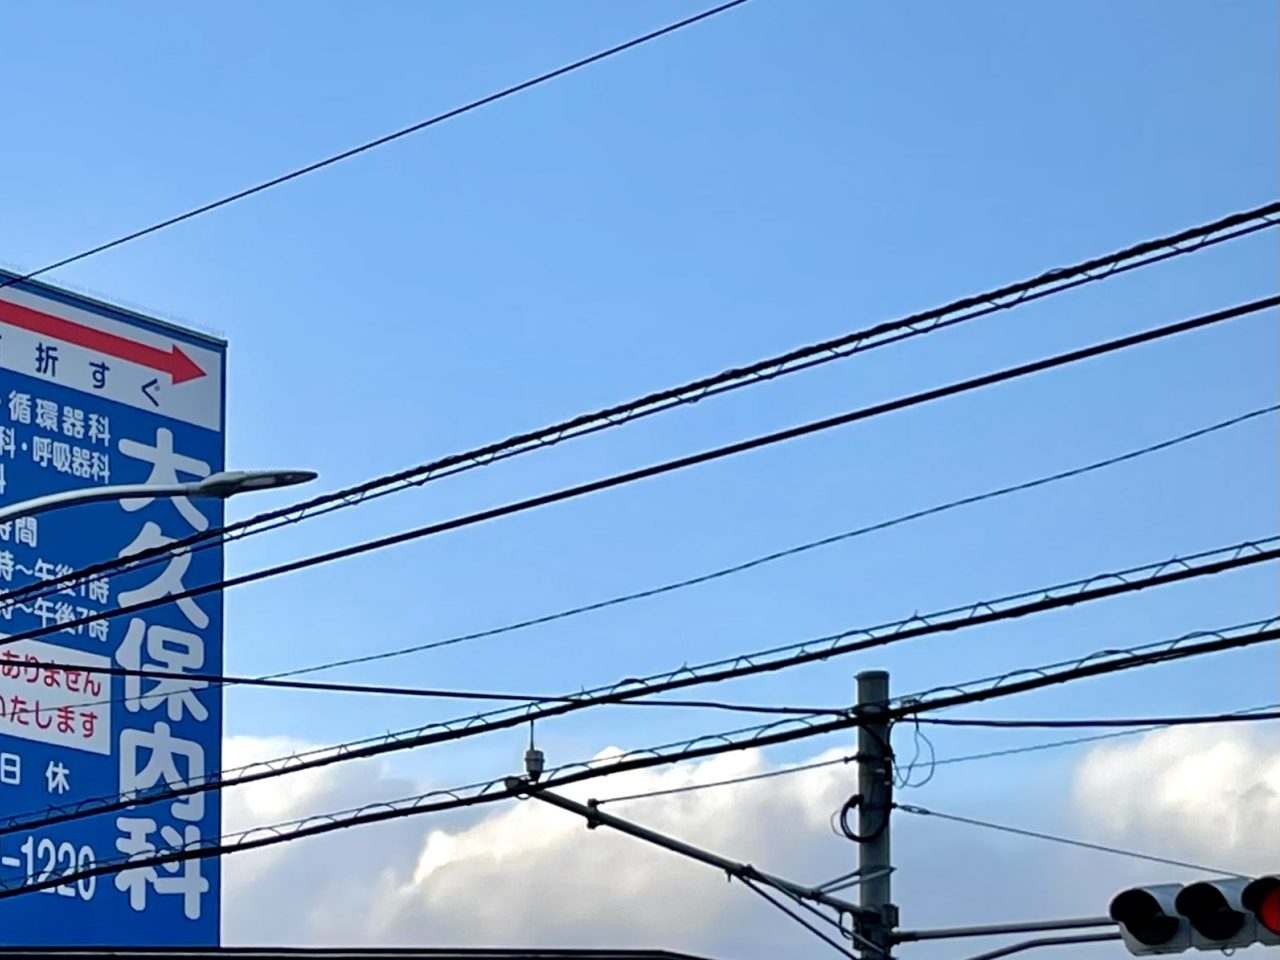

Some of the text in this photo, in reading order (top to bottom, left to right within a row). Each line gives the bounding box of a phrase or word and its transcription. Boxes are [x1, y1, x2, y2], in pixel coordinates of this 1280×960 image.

[46, 760, 70, 795] 休
[115, 427, 211, 921] 大久保内科
